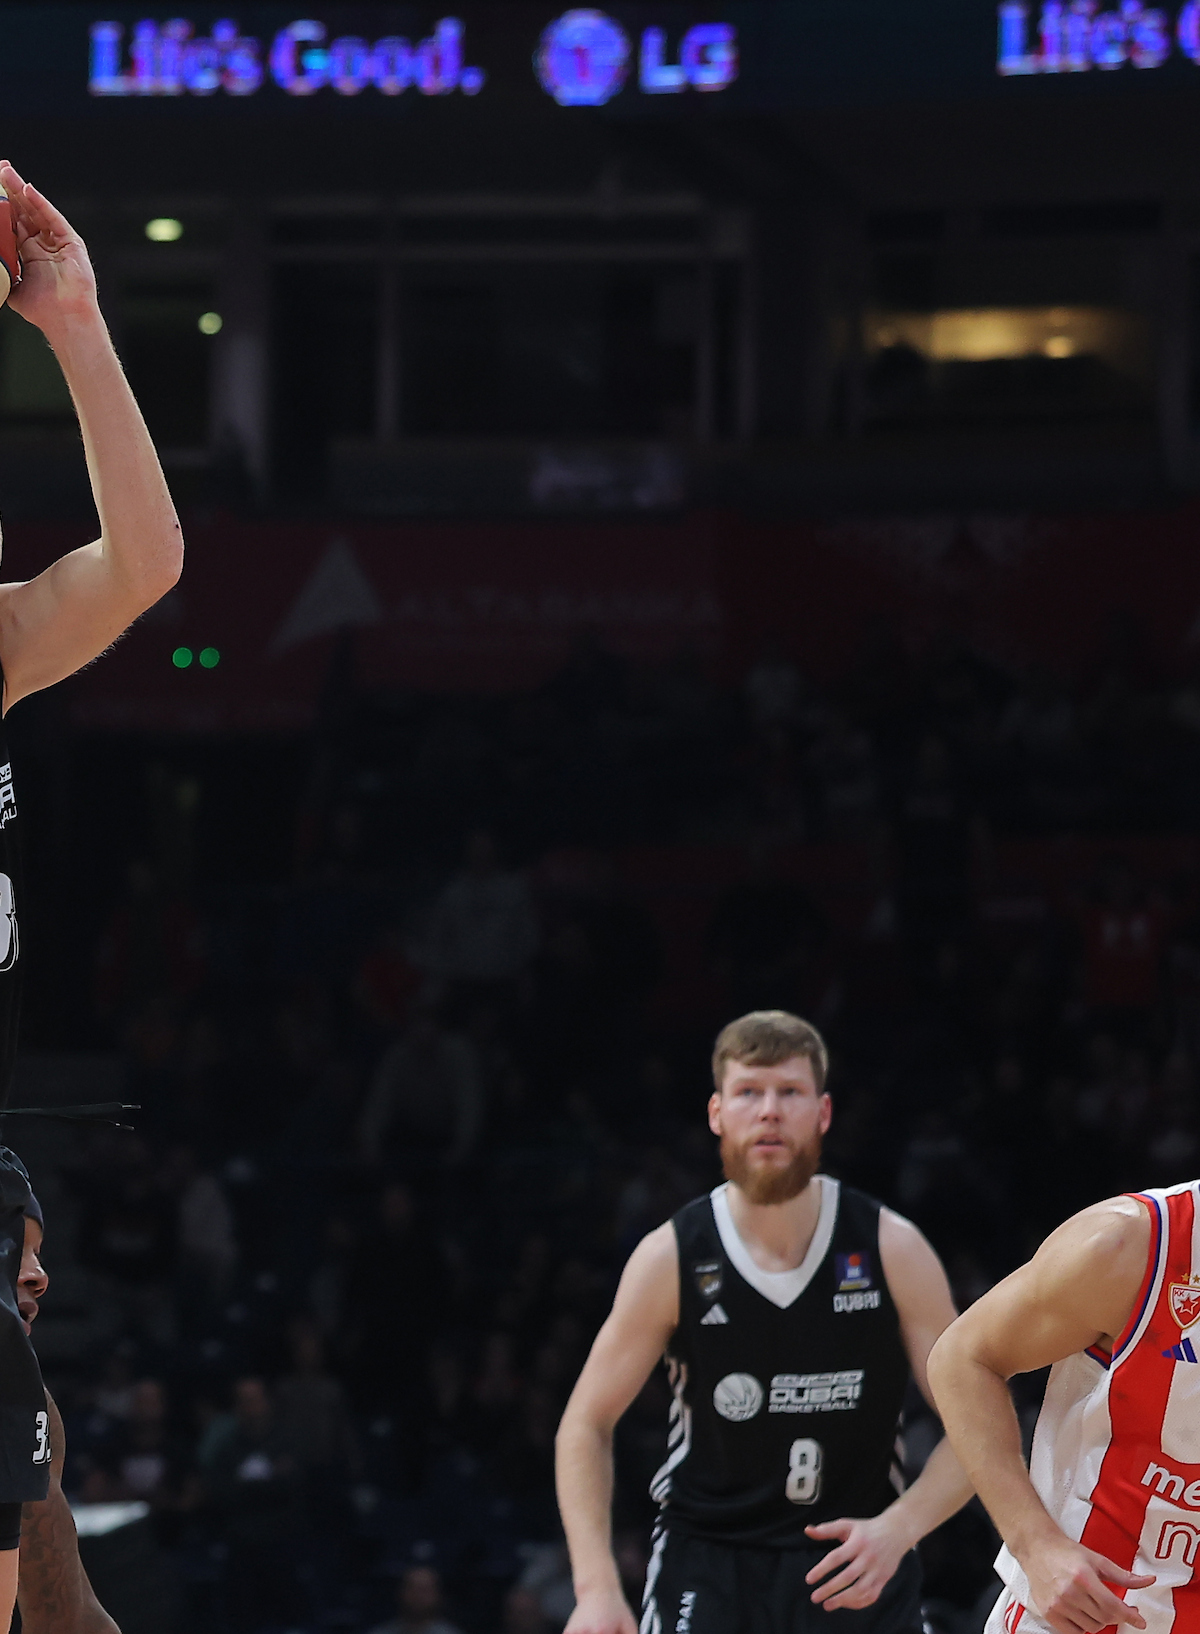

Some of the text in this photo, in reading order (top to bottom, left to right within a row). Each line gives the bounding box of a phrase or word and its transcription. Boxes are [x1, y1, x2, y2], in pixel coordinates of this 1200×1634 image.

[89, 17, 486, 95] Life's Good.
[640, 22, 740, 94] LG
[769, 1384, 861, 1404] DUBAI
[785, 1437, 823, 1505] 8
